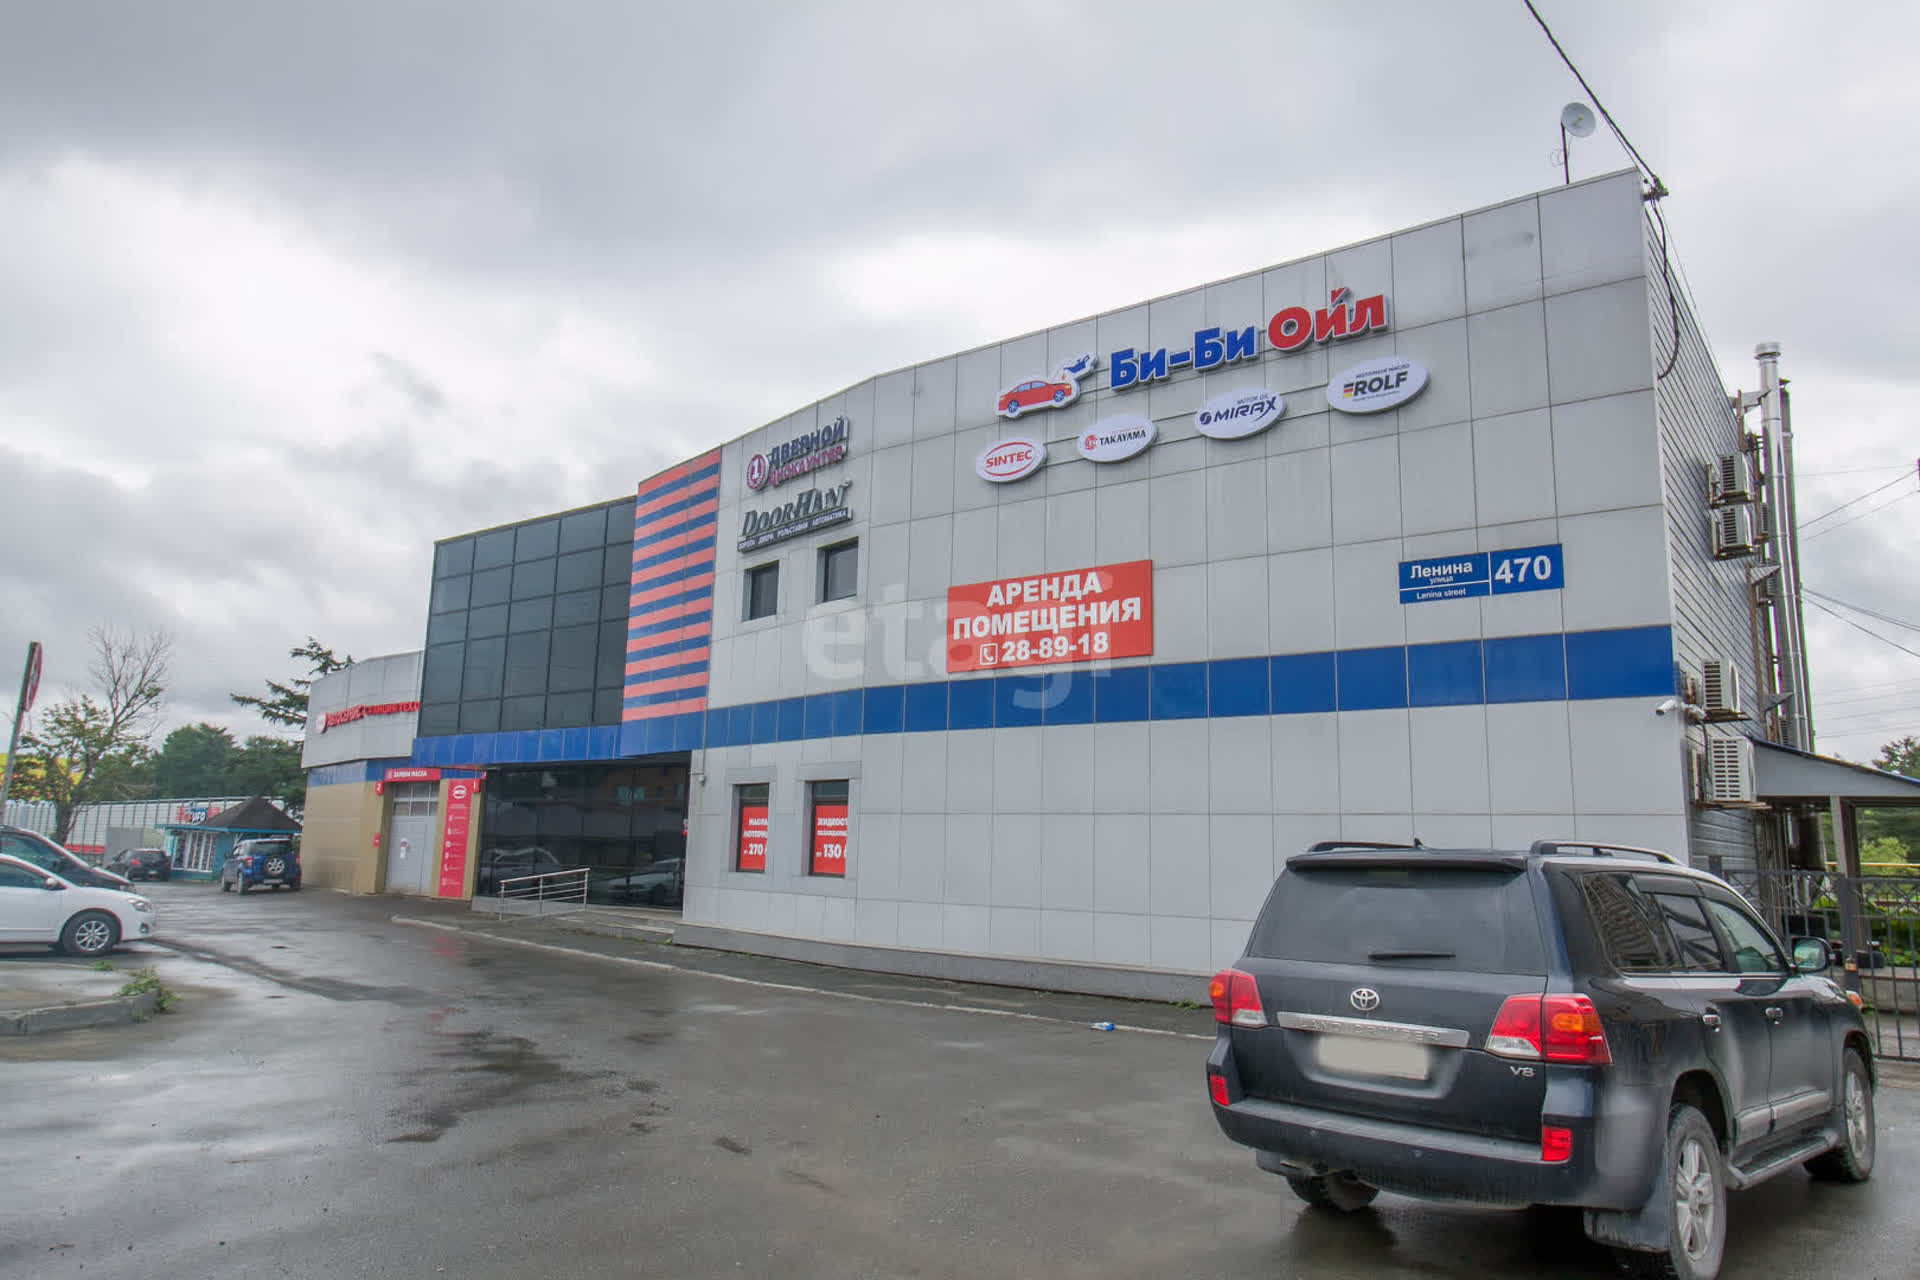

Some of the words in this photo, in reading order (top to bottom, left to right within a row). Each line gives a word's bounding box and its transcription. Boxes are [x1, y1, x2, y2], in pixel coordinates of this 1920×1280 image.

[1110, 325, 1256, 390] Би-Би
[1267, 287, 1388, 351] Ойл
[1353, 371, 1408, 397] ROLF
[1213, 396, 1277, 422] MIRAX
[769, 416, 848, 468] ДВЕРНОЙ
[1099, 429, 1147, 446] TAKAYAMA
[768, 444, 844, 486] ДИСКАУНТЕР
[986, 449, 1033, 468] SINTEC
[1410, 560, 1473, 579] Ленина
[1429, 575, 1454, 586] улица
[1494, 555, 1552, 584] 470
[986, 571, 1102, 607] АРЕНДА
[1416, 588, 1443, 600] Lenina
[1443, 587, 1467, 598] street
[952, 597, 1141, 640] ПОМЕЩЕНИЯ
[1001, 631, 1109, 663] 28-89-18
[748, 843, 763, 856] 270
[823, 844, 842, 859] 130
[1509, 1065, 1535, 1078] V8
